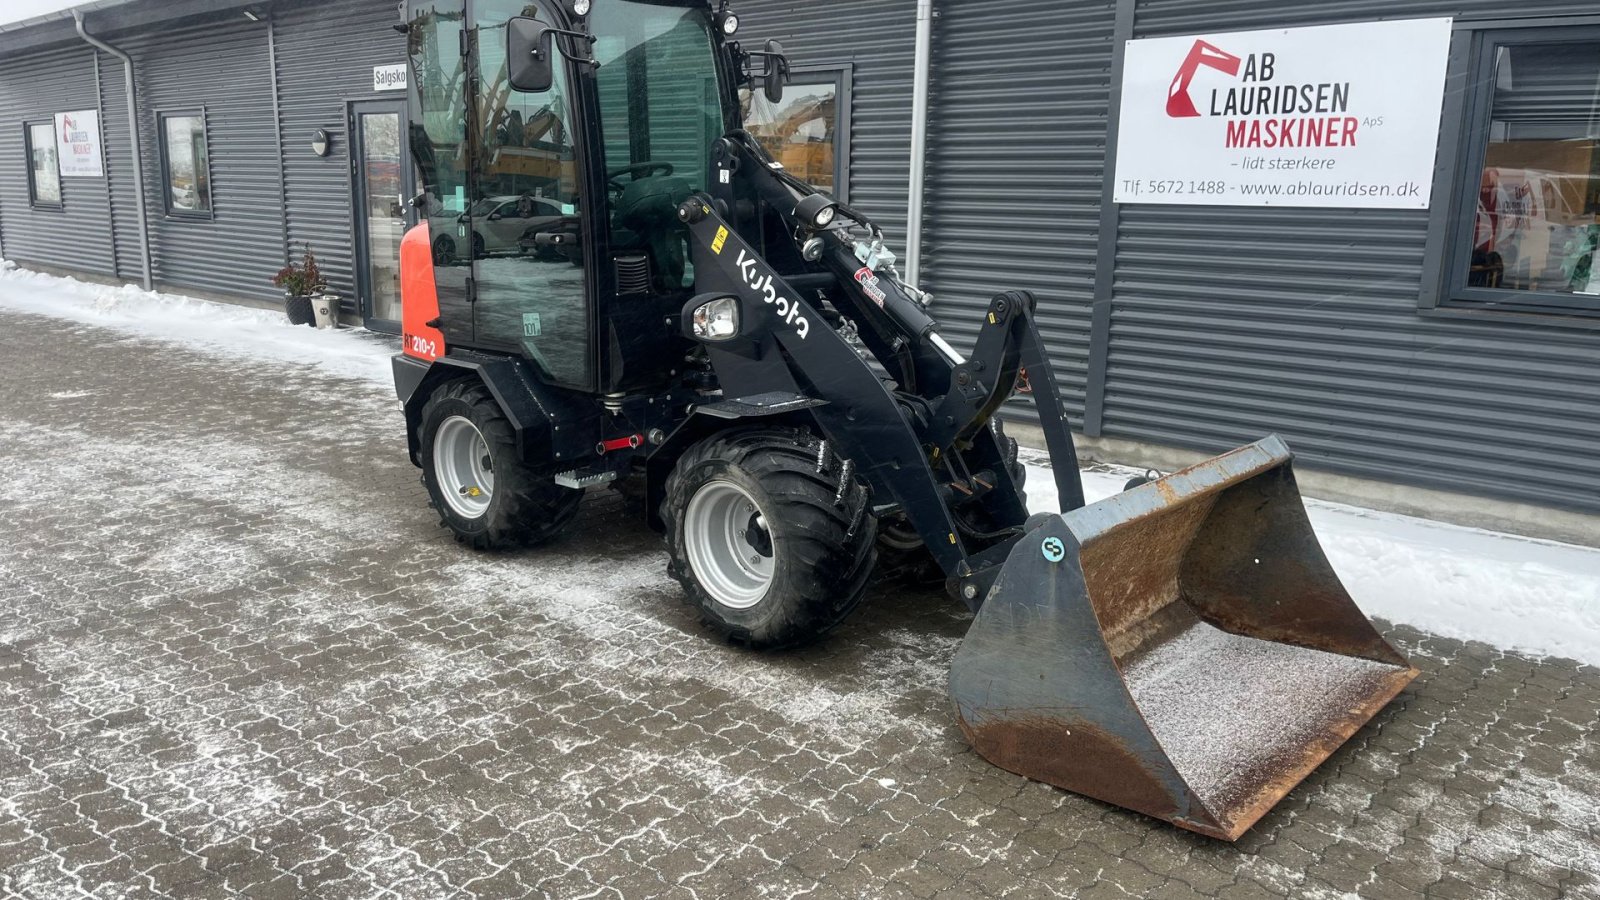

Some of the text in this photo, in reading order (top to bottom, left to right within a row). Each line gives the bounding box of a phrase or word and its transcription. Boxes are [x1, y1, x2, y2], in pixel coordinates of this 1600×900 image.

[375, 69, 406, 86] Salgsko
[1243, 52, 1275, 82] AB
[1210, 82, 1350, 116] LAURIDSEN
[1225, 116, 1384, 149] MASKINER ApS
[1242, 156, 1266, 170] lidt
[1267, 156, 1336, 171] stærkere
[1122, 180, 1144, 196] Tlf.
[1148, 180, 1184, 195] 5672
[1188, 180, 1226, 195] 1488
[1240, 181, 1421, 197] www.ablauridsen.dk
[735, 248, 810, 340] Kubota
